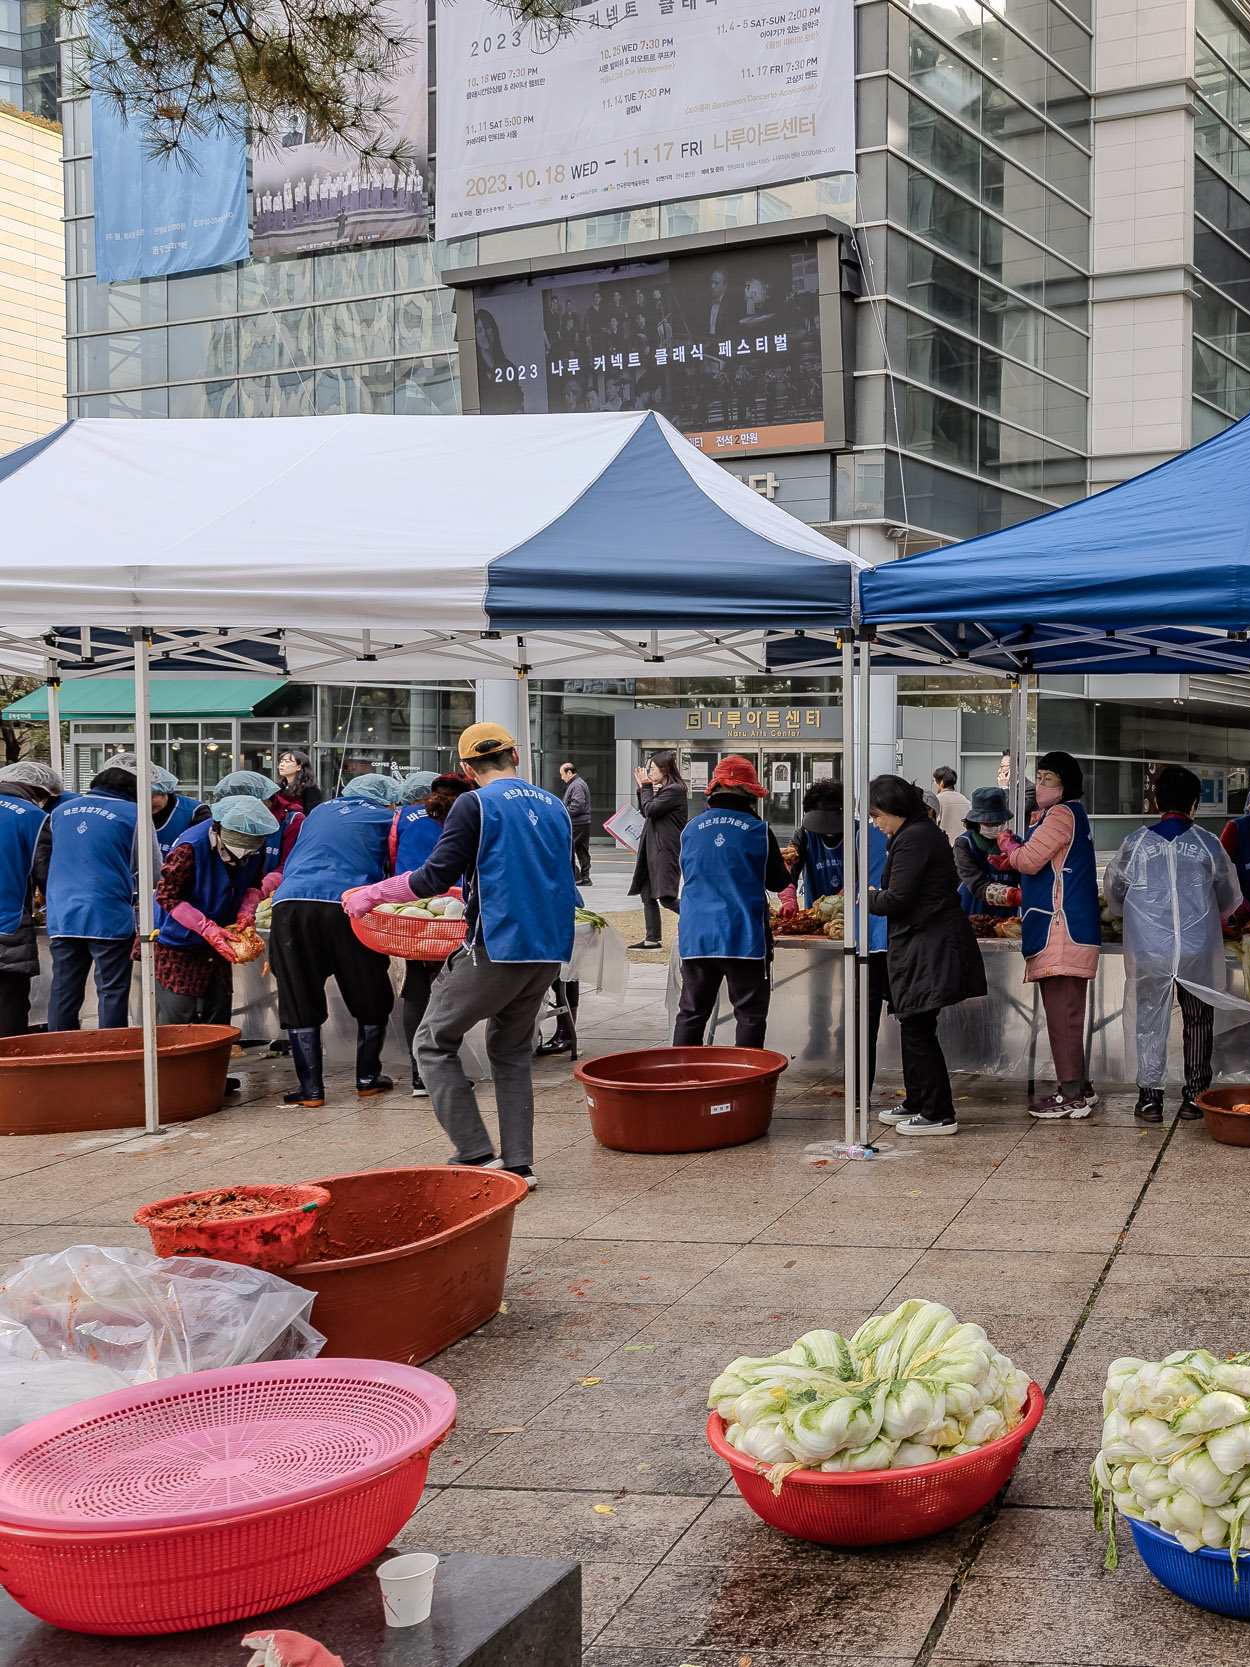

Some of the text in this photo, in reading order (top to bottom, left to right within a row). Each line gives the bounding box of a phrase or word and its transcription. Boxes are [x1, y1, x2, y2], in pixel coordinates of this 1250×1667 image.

[750, 15, 786, 28] SAT-SUN
[788, 8, 808, 21] 2:00
[809, 6, 821, 16] PM
[760, 28, 785, 39] 이야기가
[787, 25, 800, 35] 있는
[471, 31, 521, 57] 2023
[621, 43, 638, 53] WED
[640, 39, 660, 50] 7:30
[662, 38, 674, 47] PM
[625, 57, 629, 65] &
[757, 65, 767, 76] 17
[770, 65, 784, 75] FRI
[786, 59, 805, 73] 7:30
[806, 57, 818, 67] PM
[481, 73, 489, 84] 18
[490, 73, 507, 82] WED
[508, 67, 526, 79] 7:30
[527, 67, 538, 76] PM
[504, 83, 509, 92] &
[614, 95, 623, 106] 14
[624, 92, 637, 103] TUE
[639, 88, 657, 100] 7:30
[659, 87, 671, 96] PM
[747, 91, 777, 104] Concerto
[489, 121, 503, 130] SAT
[504, 115, 522, 127] 5:00
[523, 115, 534, 124] PM
[506, 130, 518, 139] 서울
[466, 173, 512, 198] 2023.
[517, 169, 541, 190] 10.
[545, 164, 566, 185] 18
[571, 160, 599, 180] WED
[624, 147, 648, 169] 11.
[653, 141, 675, 163] 17
[681, 140, 703, 159] FRI
[713, 112, 817, 153] 나루아트센터
[494, 333, 788, 383] 2023 나루 커넥트 클래식 페스티벌
[715, 434, 733, 447] 전석
[734, 432, 758, 445] 2만원
[708, 710, 822, 729] 나루아트센터
[728, 730, 801, 738] Naru Arts Center
[390, 761, 398, 771] &
[64, 806, 118, 820] 바르게살기운동
[698, 816, 750, 831] 바르게살기운동
